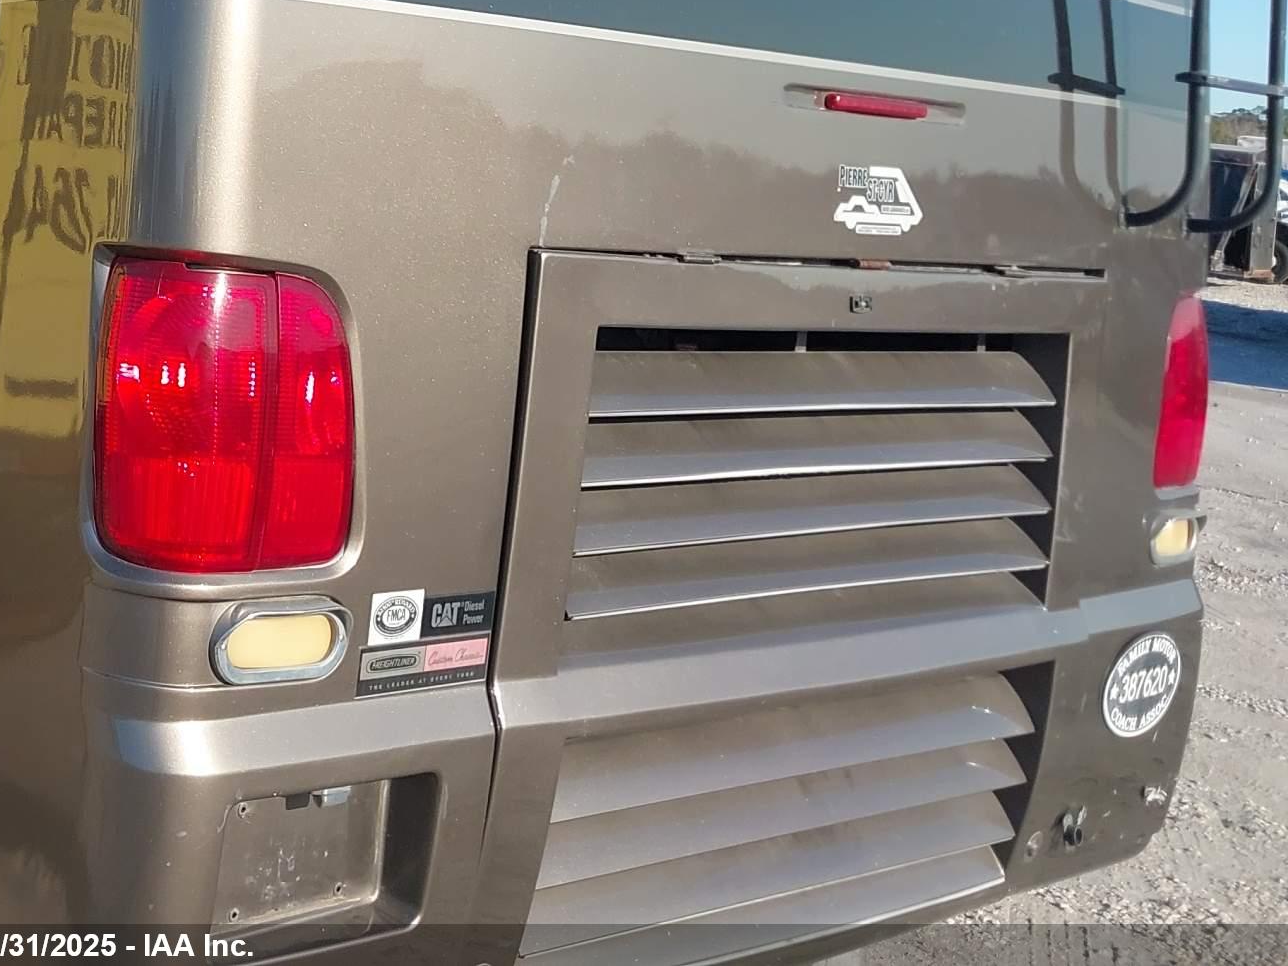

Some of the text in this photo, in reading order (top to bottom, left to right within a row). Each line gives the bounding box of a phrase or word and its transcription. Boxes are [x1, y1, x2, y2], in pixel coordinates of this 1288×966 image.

[839, 165, 867, 187] PIERRE
[386, 608, 406, 623] FMCA
[431, 601, 461, 628] CAT
[464, 599, 485, 611] Diesel
[462, 613, 484, 625] Power
[371, 656, 415, 670] FREIGHTLINER
[1117, 637, 1177, 676] FAMILY MOTOR
[1119, 665, 1169, 703] 387620
[1110, 707, 1137, 731] COACH
